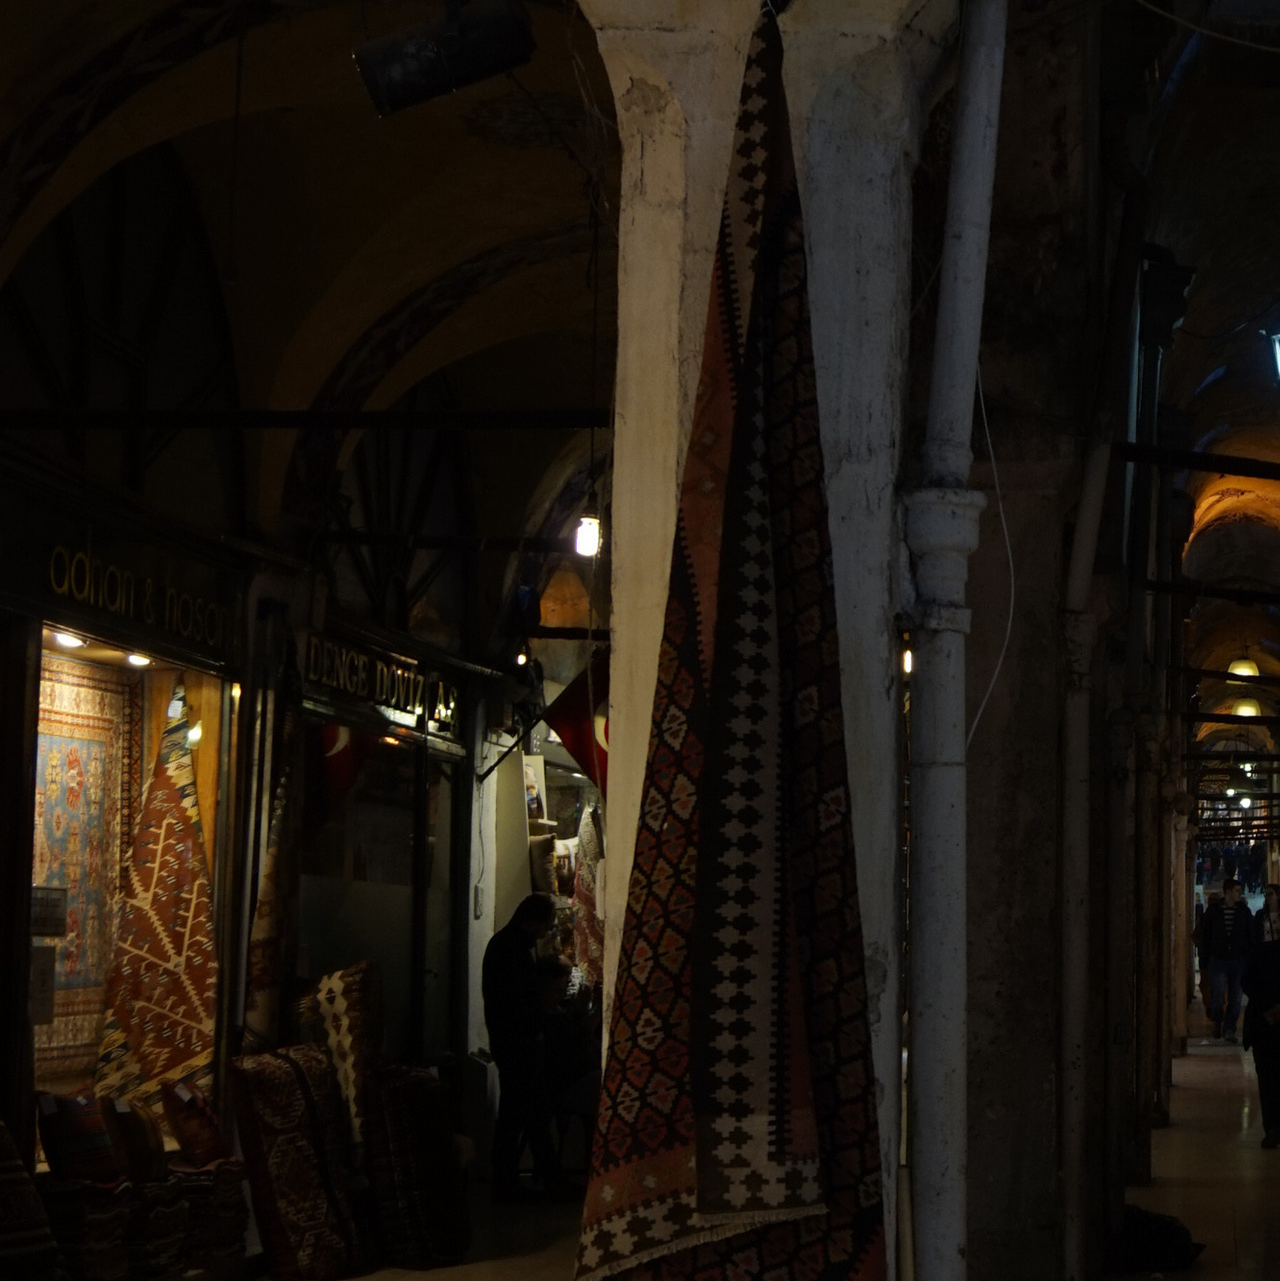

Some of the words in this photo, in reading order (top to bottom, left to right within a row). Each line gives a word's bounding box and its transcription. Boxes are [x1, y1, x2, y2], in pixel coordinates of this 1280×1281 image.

[49, 525, 135, 619] adnan
[142, 576, 155, 625] &
[308, 635, 370, 697] DENGE
